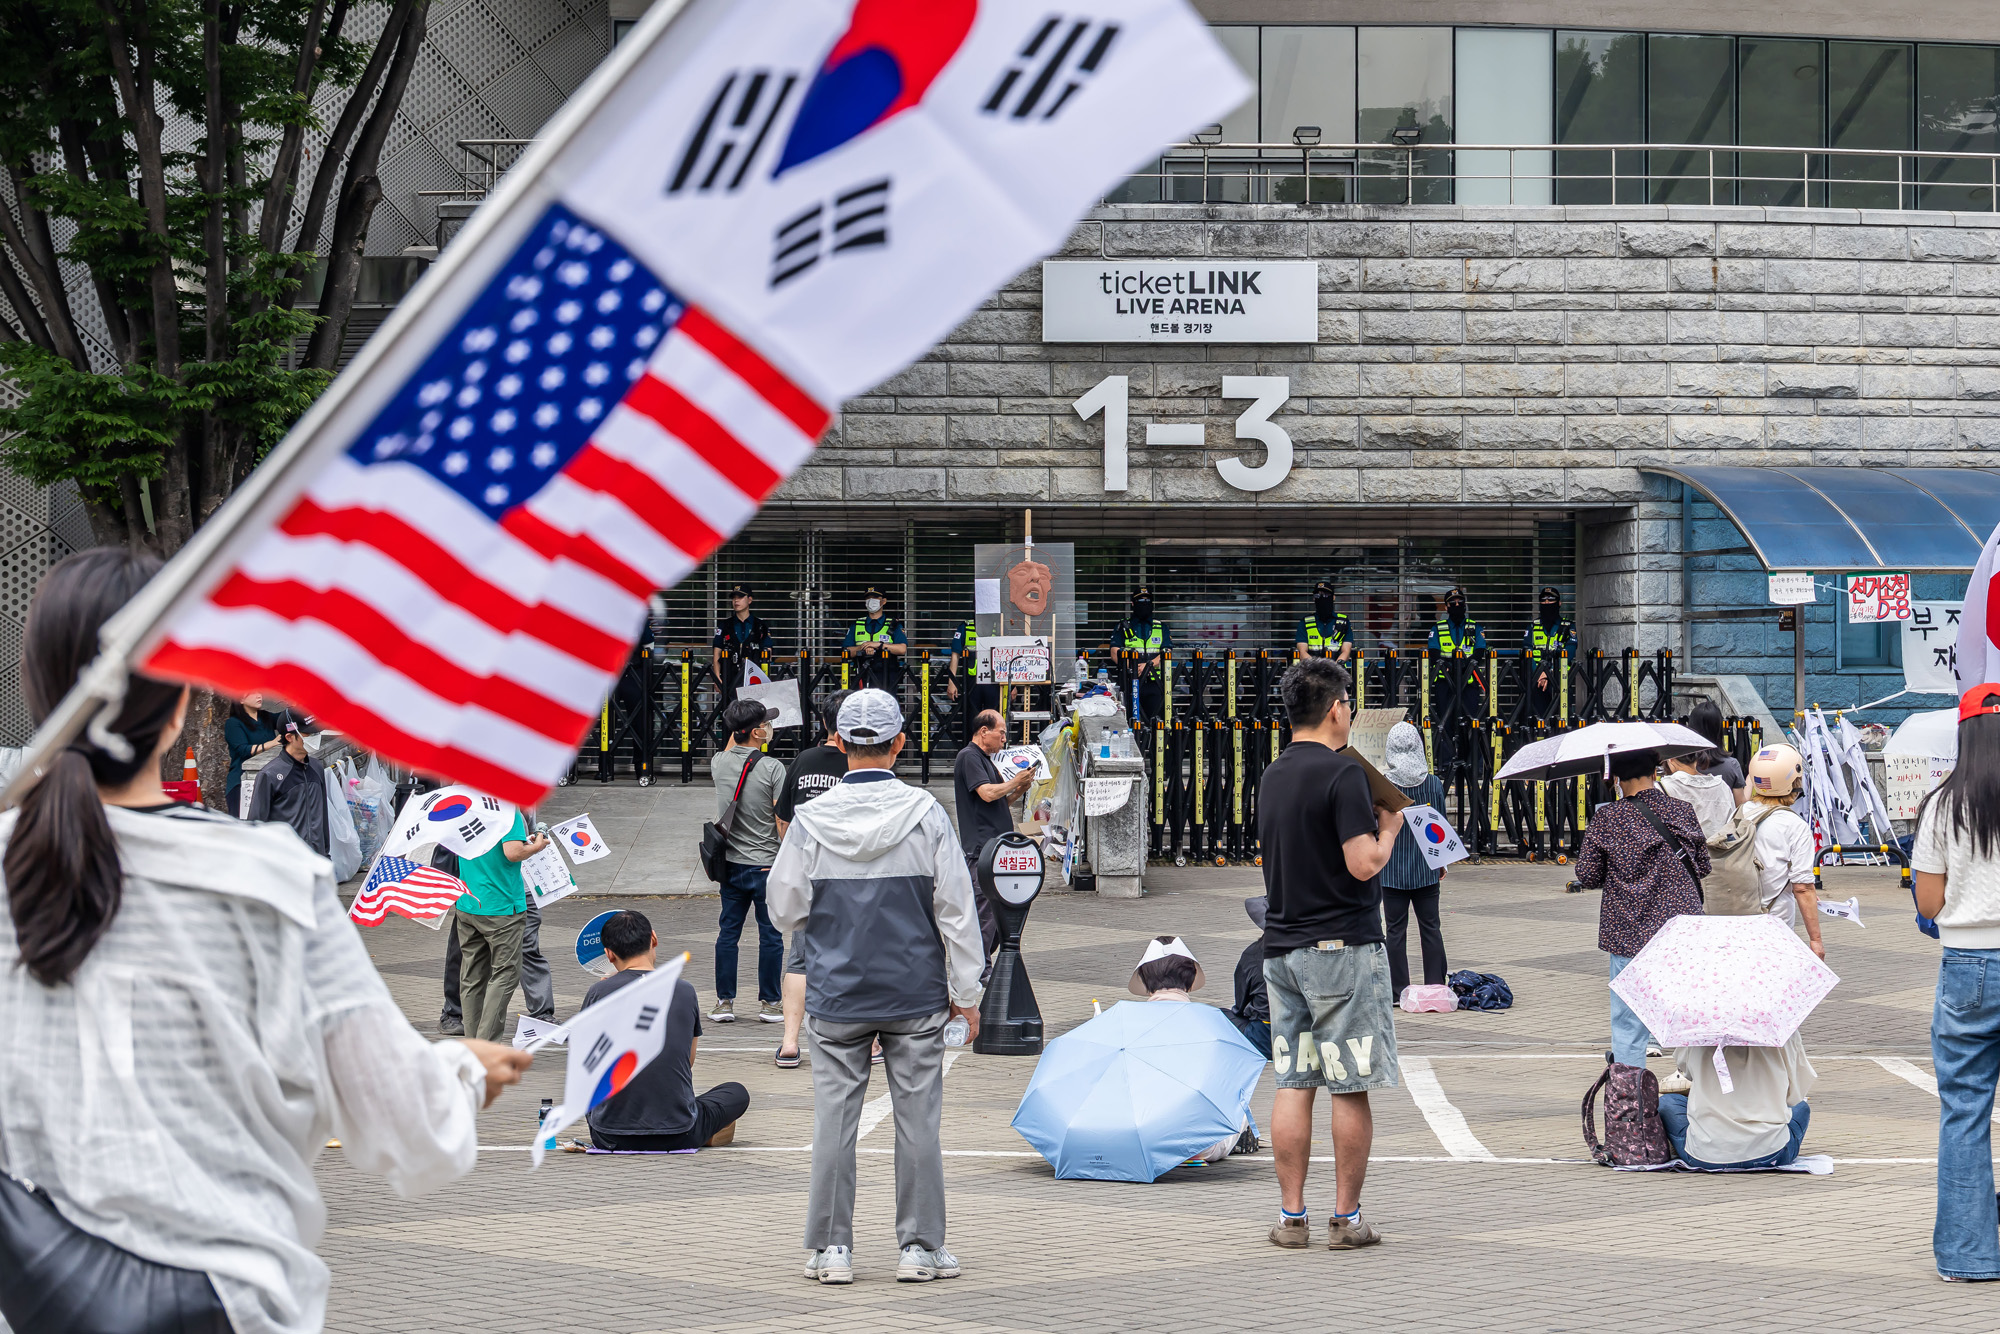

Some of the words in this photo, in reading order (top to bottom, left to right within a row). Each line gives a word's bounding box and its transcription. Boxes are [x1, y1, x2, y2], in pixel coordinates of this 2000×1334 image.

[1100, 271, 1262, 295] ticketLINK
[1116, 298, 1164, 315] LIVE
[1169, 298, 1245, 315] ARENA
[1150, 322, 1180, 335] 핸드볼
[1183, 322, 1213, 335] 경기장
[1072, 375, 1294, 492] 1-3
[1877, 598, 1911, 620] D-8
[998, 856, 1037, 871] 색칠금지
